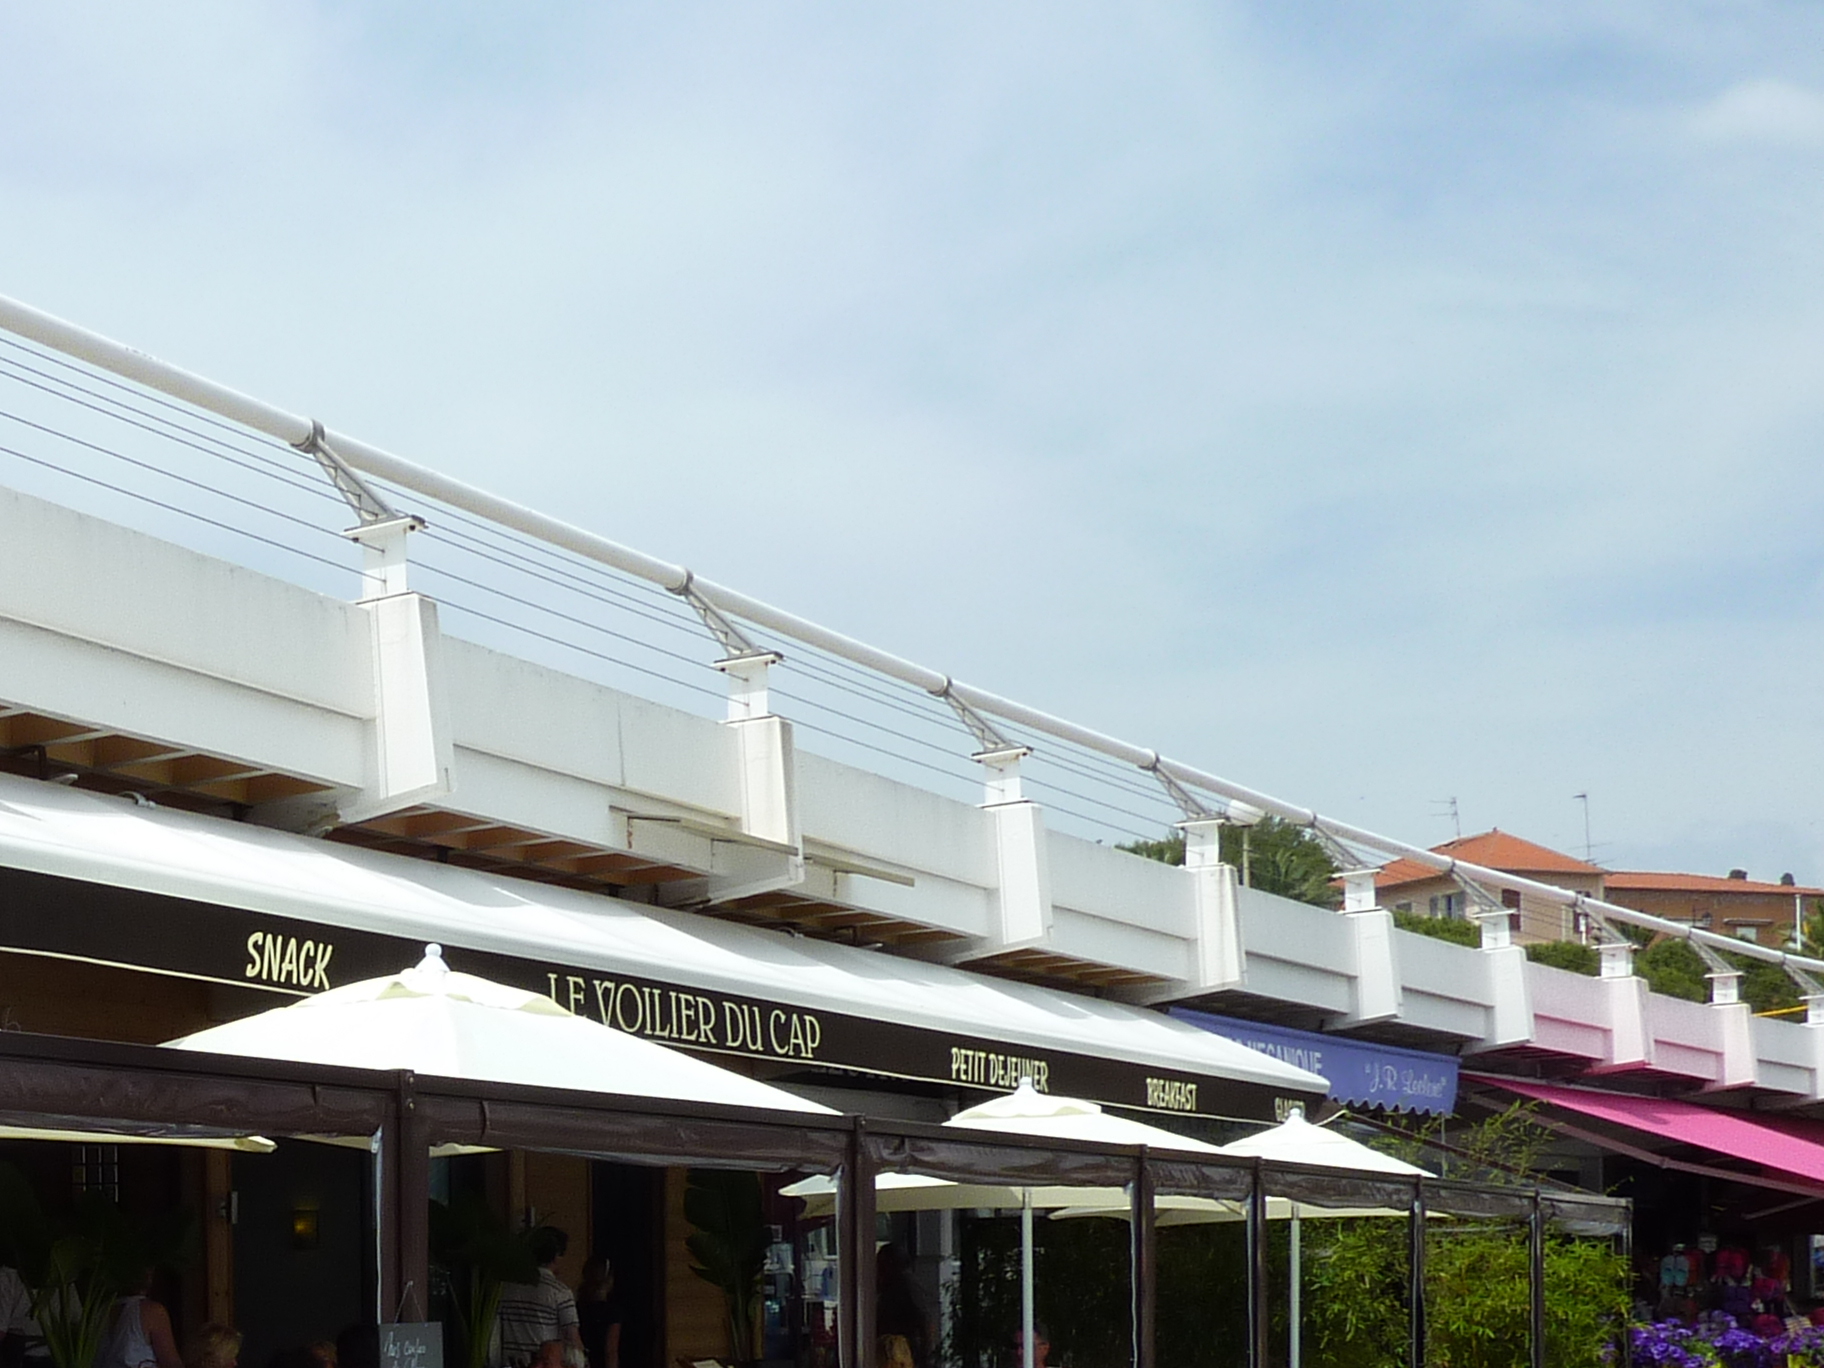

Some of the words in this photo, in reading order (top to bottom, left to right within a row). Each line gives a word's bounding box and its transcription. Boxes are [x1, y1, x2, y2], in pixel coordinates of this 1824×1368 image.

[246, 930, 334, 991] SNACK
[547, 973, 586, 1016] LE
[593, 979, 717, 1044] VOILIER
[723, 1000, 764, 1051] DU
[769, 1010, 822, 1059] CAP
[951, 1047, 987, 1084] PETIT
[988, 1053, 1050, 1093] DEJEUNER
[1145, 1077, 1197, 1113] BREAKFAST
